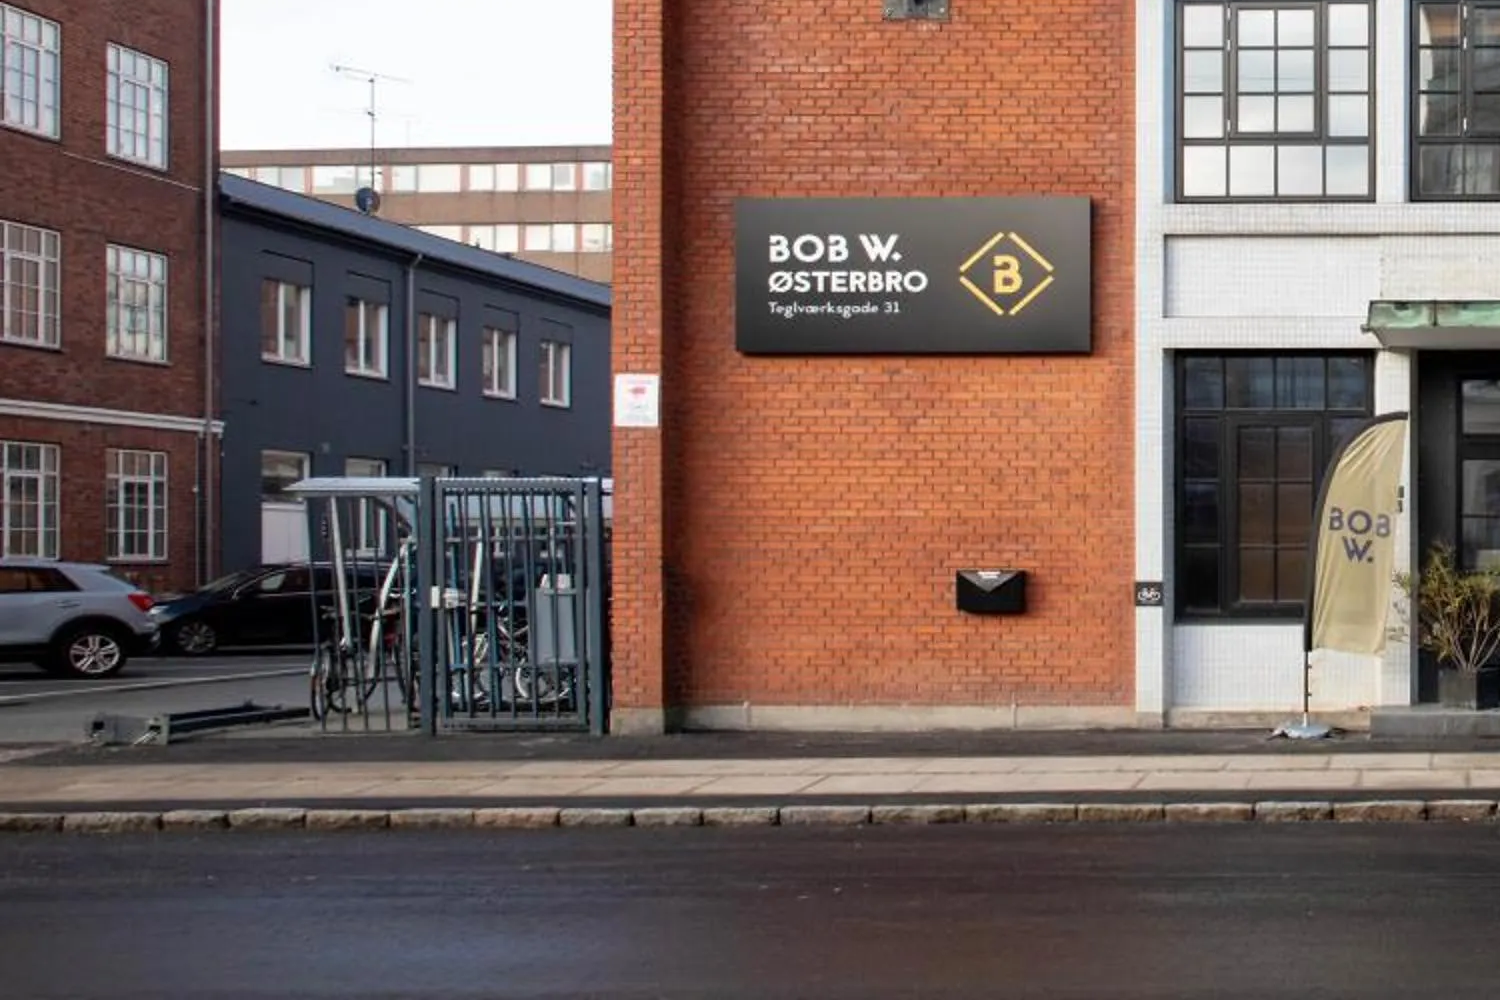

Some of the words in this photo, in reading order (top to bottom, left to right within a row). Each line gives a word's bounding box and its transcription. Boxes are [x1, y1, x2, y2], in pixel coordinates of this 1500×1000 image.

[768, 234, 849, 263] BOB
[859, 234, 903, 262] W.
[768, 270, 929, 294] ØSTERBRO
[993, 255, 1023, 294] B
[768, 301, 879, 319] Teglværksgade
[884, 302, 901, 314] 31
[1328, 507, 1391, 538] BOB
[1342, 536, 1374, 564] W.
